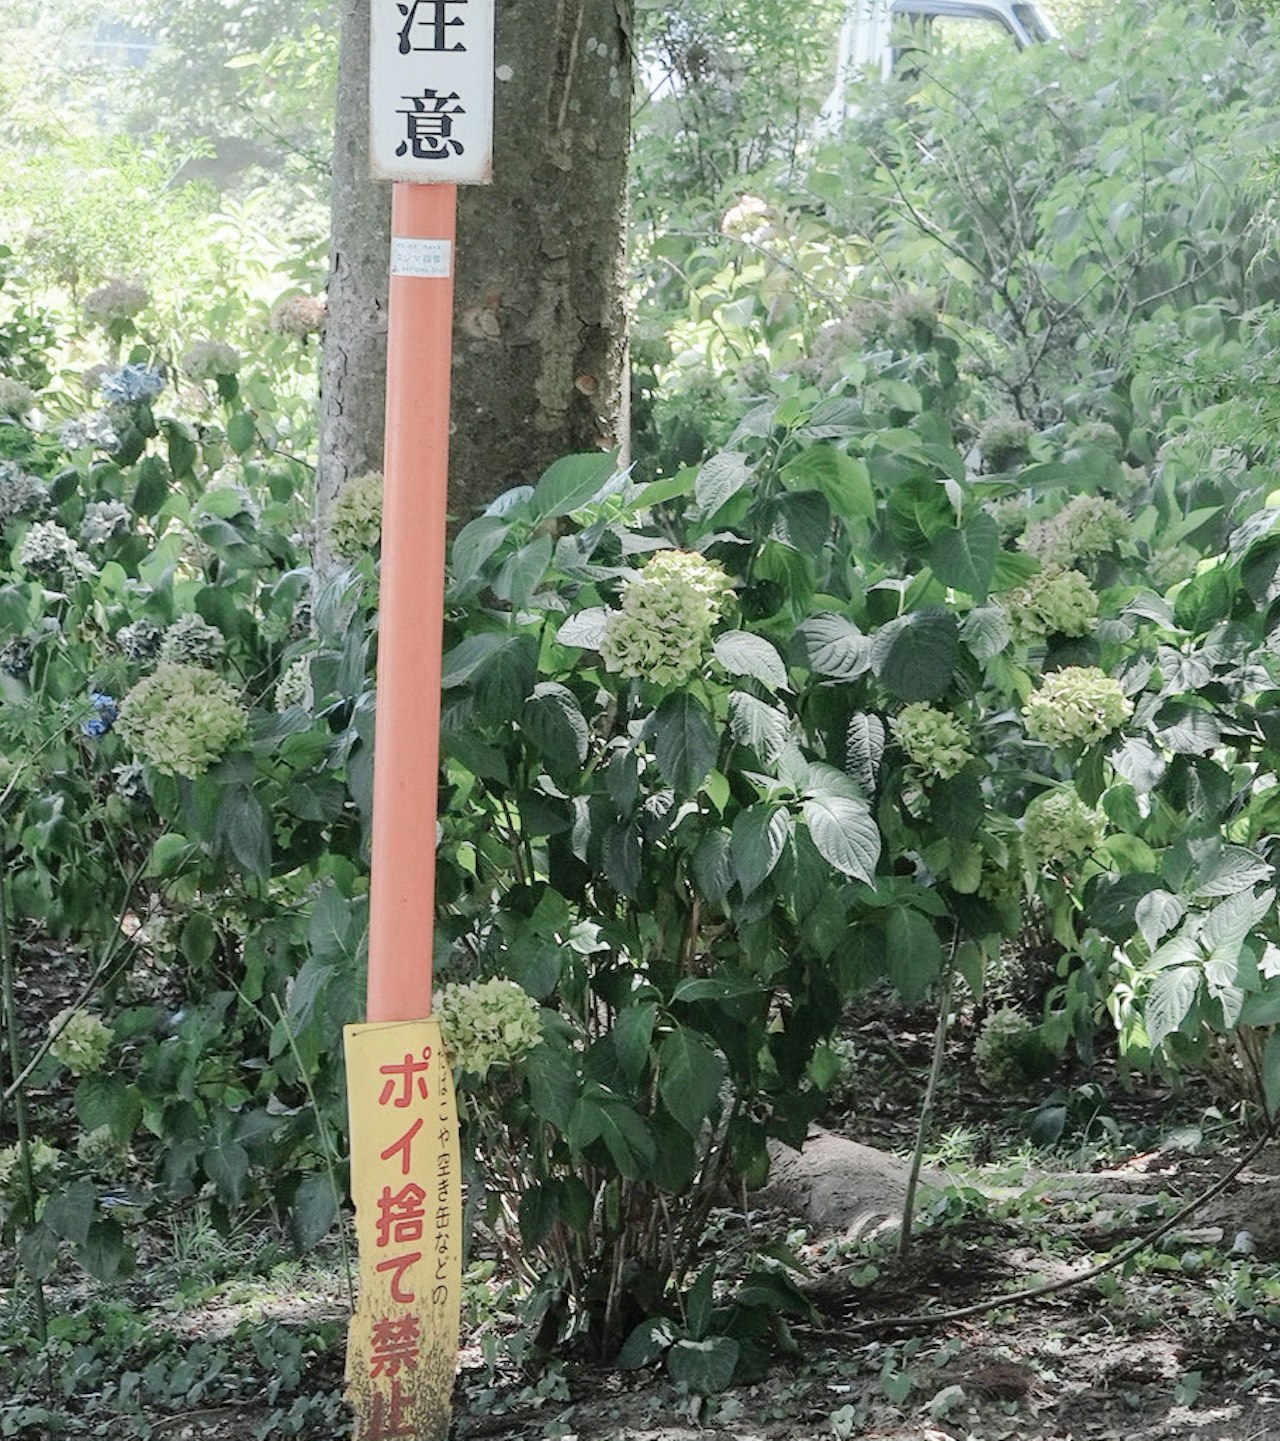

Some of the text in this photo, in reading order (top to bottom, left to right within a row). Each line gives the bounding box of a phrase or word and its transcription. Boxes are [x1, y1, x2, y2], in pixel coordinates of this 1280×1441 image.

[363, 1046, 432, 1440] ポイ捨て禁止
